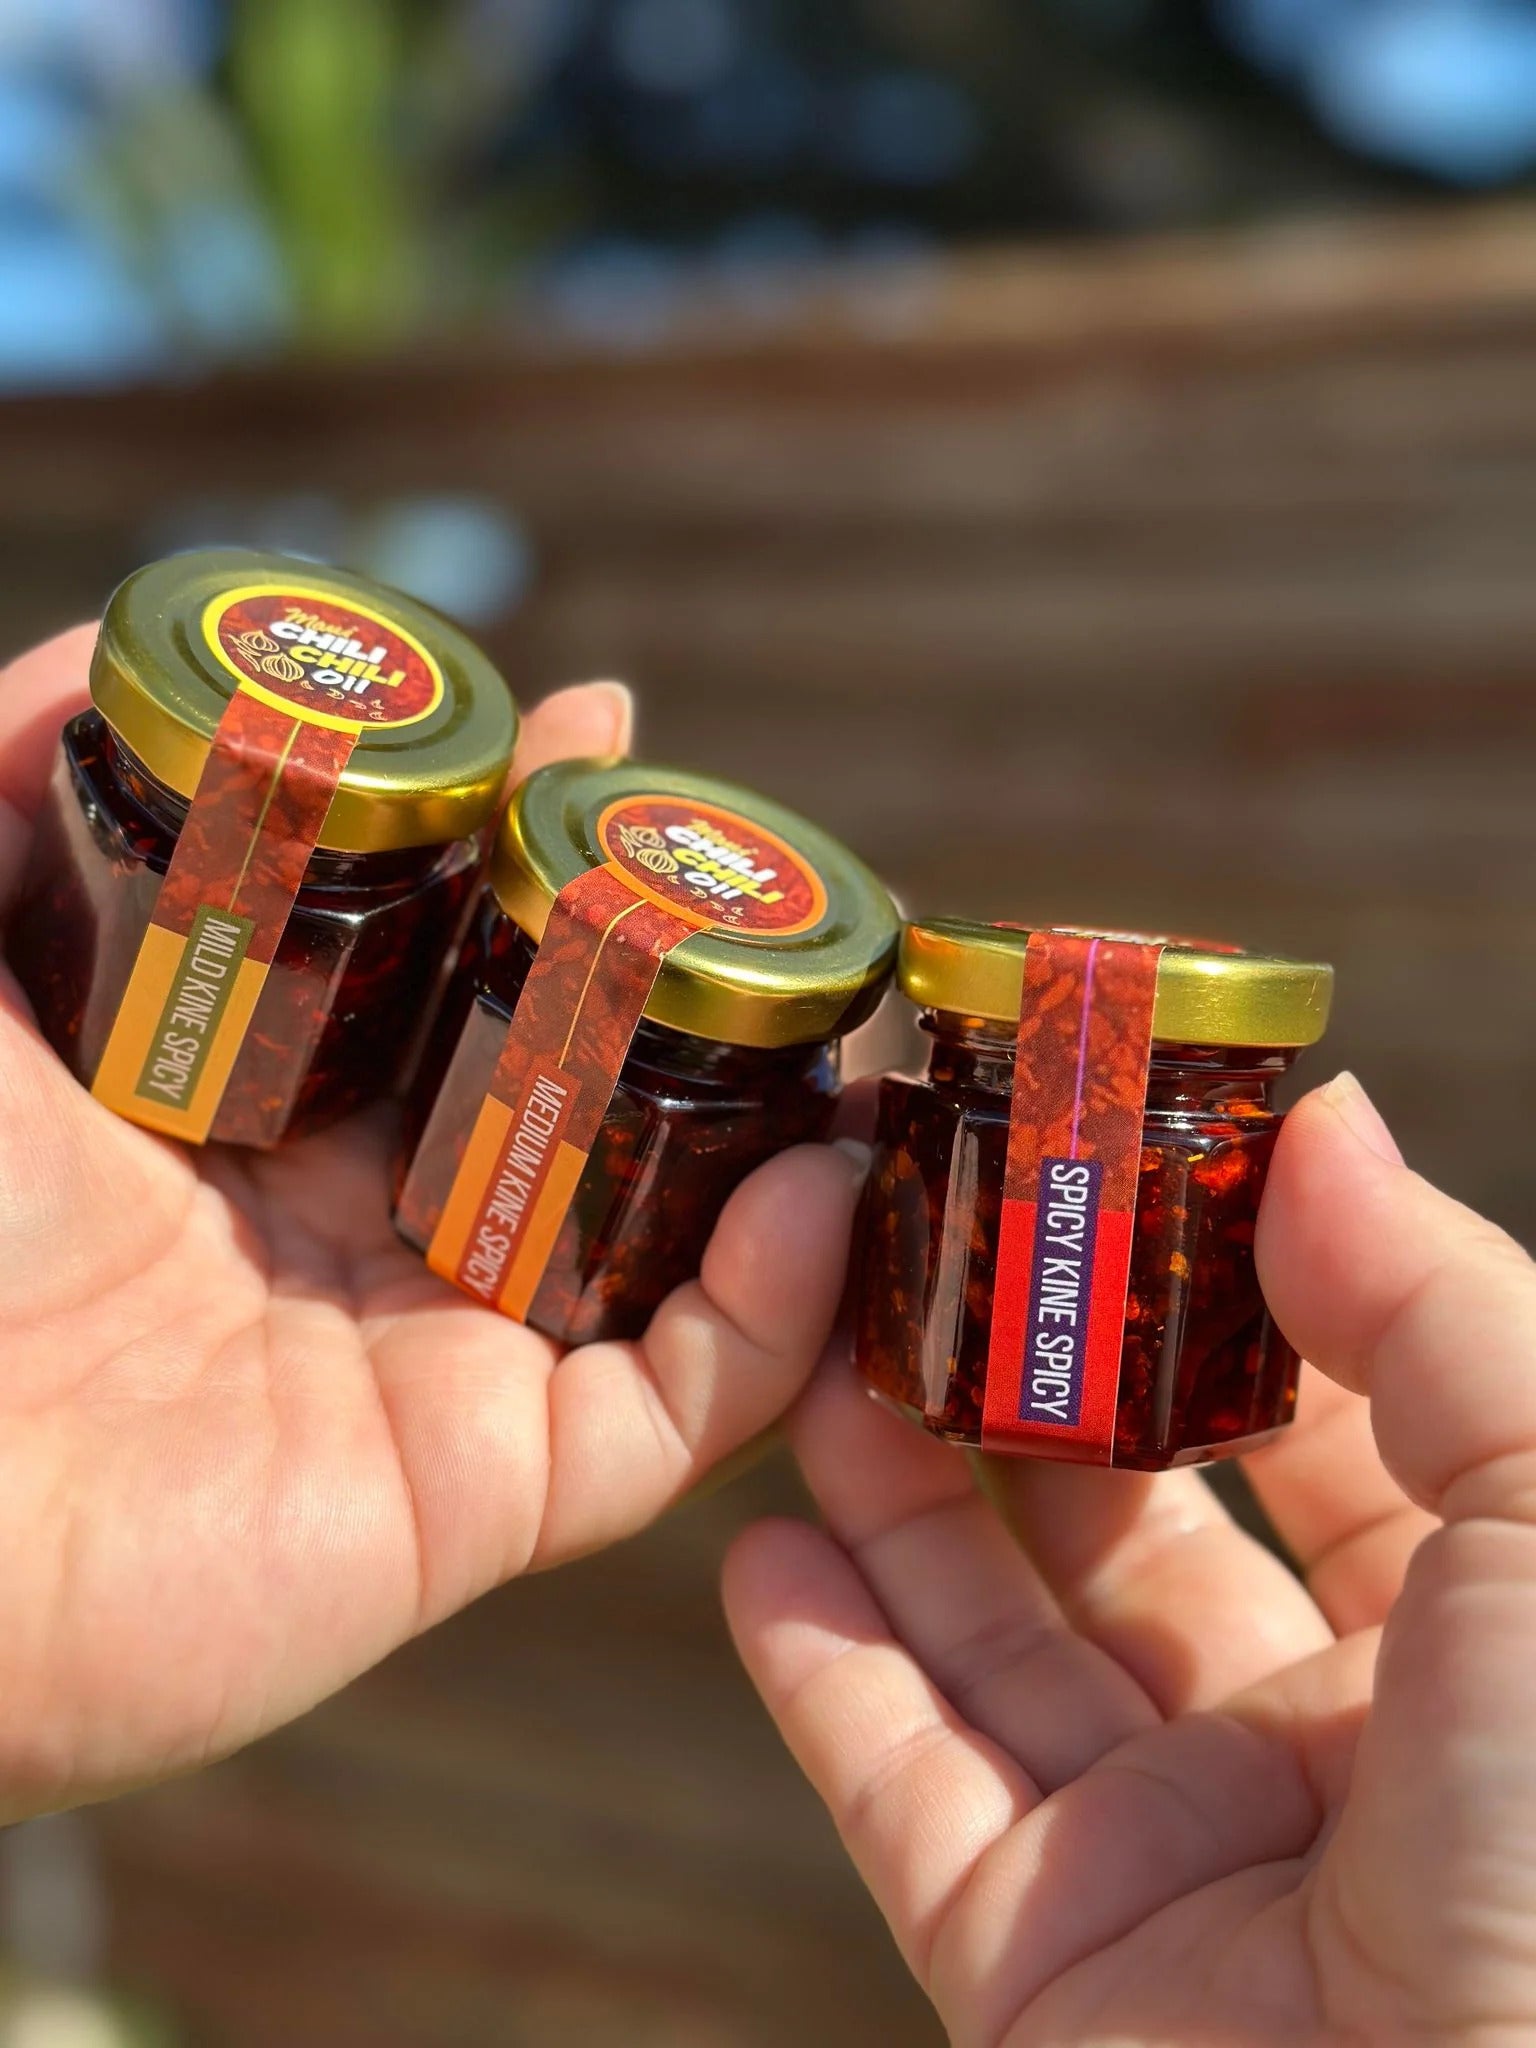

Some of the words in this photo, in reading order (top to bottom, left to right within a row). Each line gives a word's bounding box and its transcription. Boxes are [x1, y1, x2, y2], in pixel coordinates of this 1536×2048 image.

[269, 621, 388, 664] CHILI
[288, 645, 407, 687] CHILI
[665, 825, 778, 882] CHILI
[673, 848, 785, 904] CHILI
[190, 917, 240, 979] MILD
[170, 977, 221, 1034] KINE
[149, 1032, 200, 1100] SPICY
[507, 1074, 567, 1179] MEDIUM
[486, 1170, 532, 1232] KINE
[1045, 1164, 1090, 1251] SPICY
[463, 1227, 510, 1299] SPICY
[1038, 1257, 1082, 1326] KINE
[1031, 1332, 1075, 1419] SPICY
